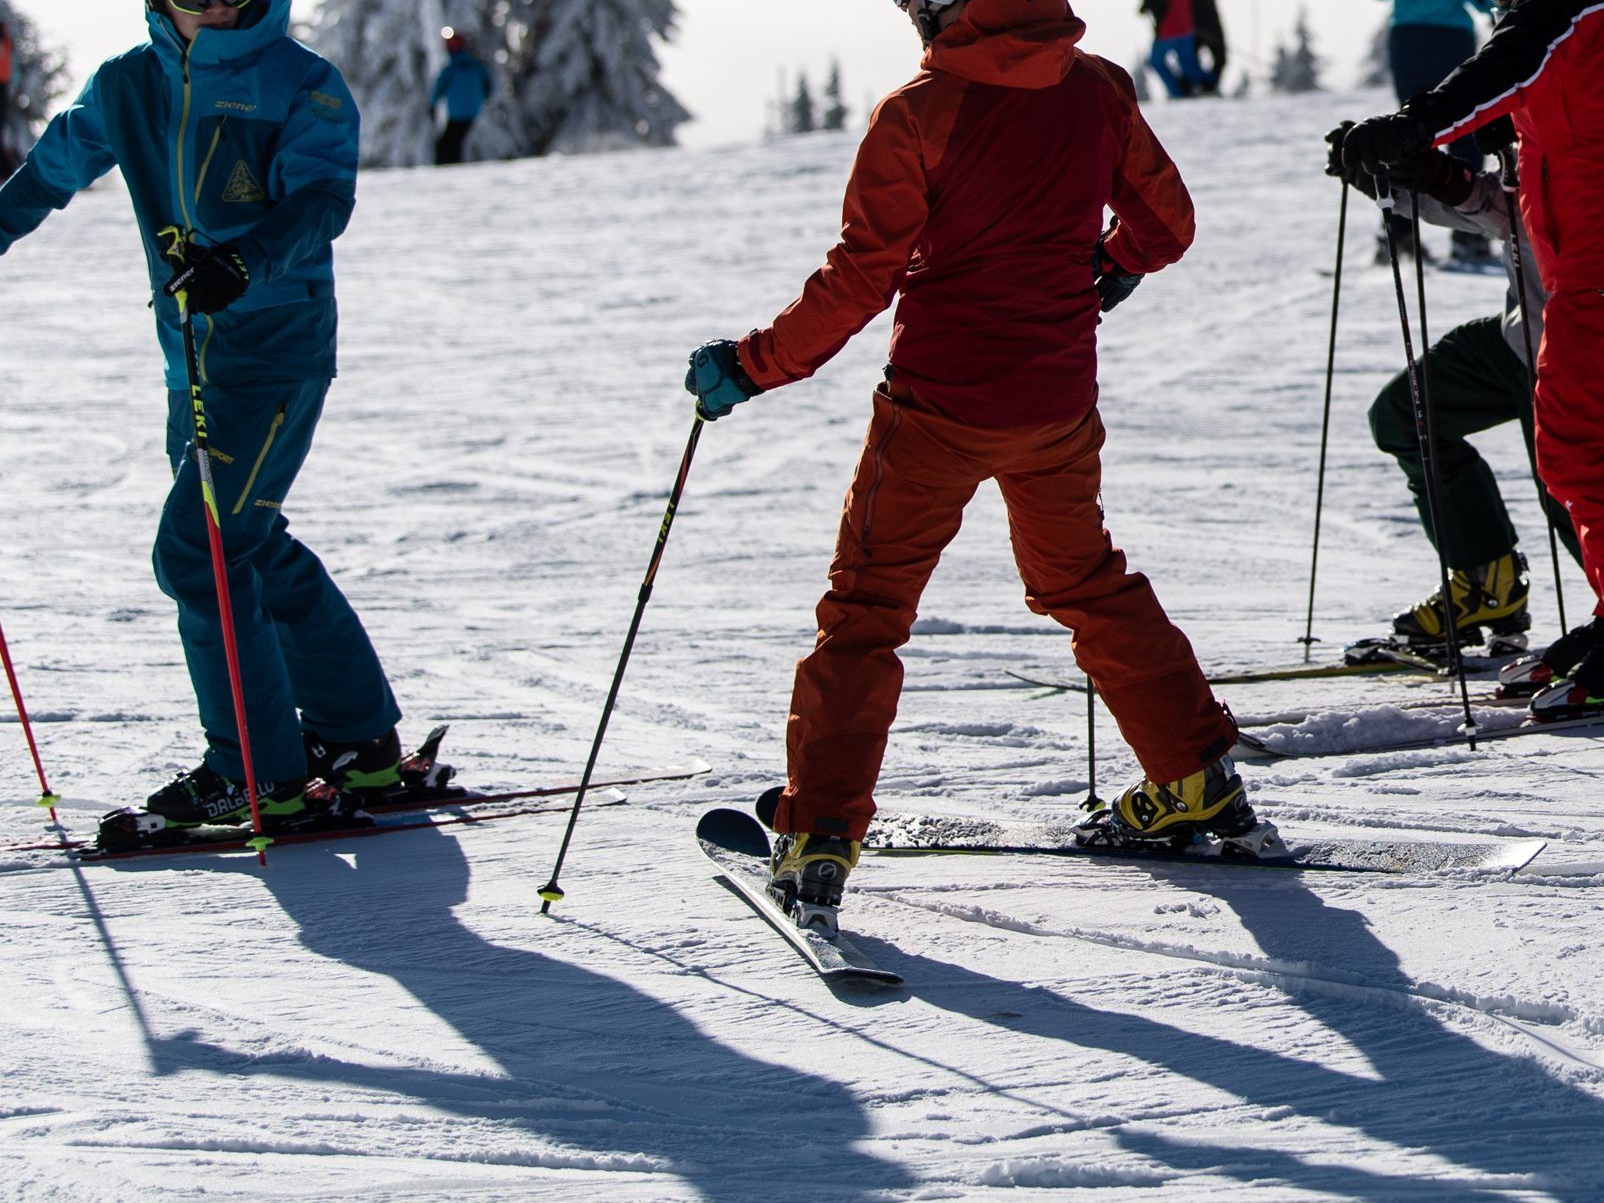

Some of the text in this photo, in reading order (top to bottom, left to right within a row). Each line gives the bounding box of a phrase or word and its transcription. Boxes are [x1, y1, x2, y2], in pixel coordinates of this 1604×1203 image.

[192, 384, 208, 438] LEKI
[658, 500, 675, 543] LEKI
[204, 781, 276, 817] DALBELO
